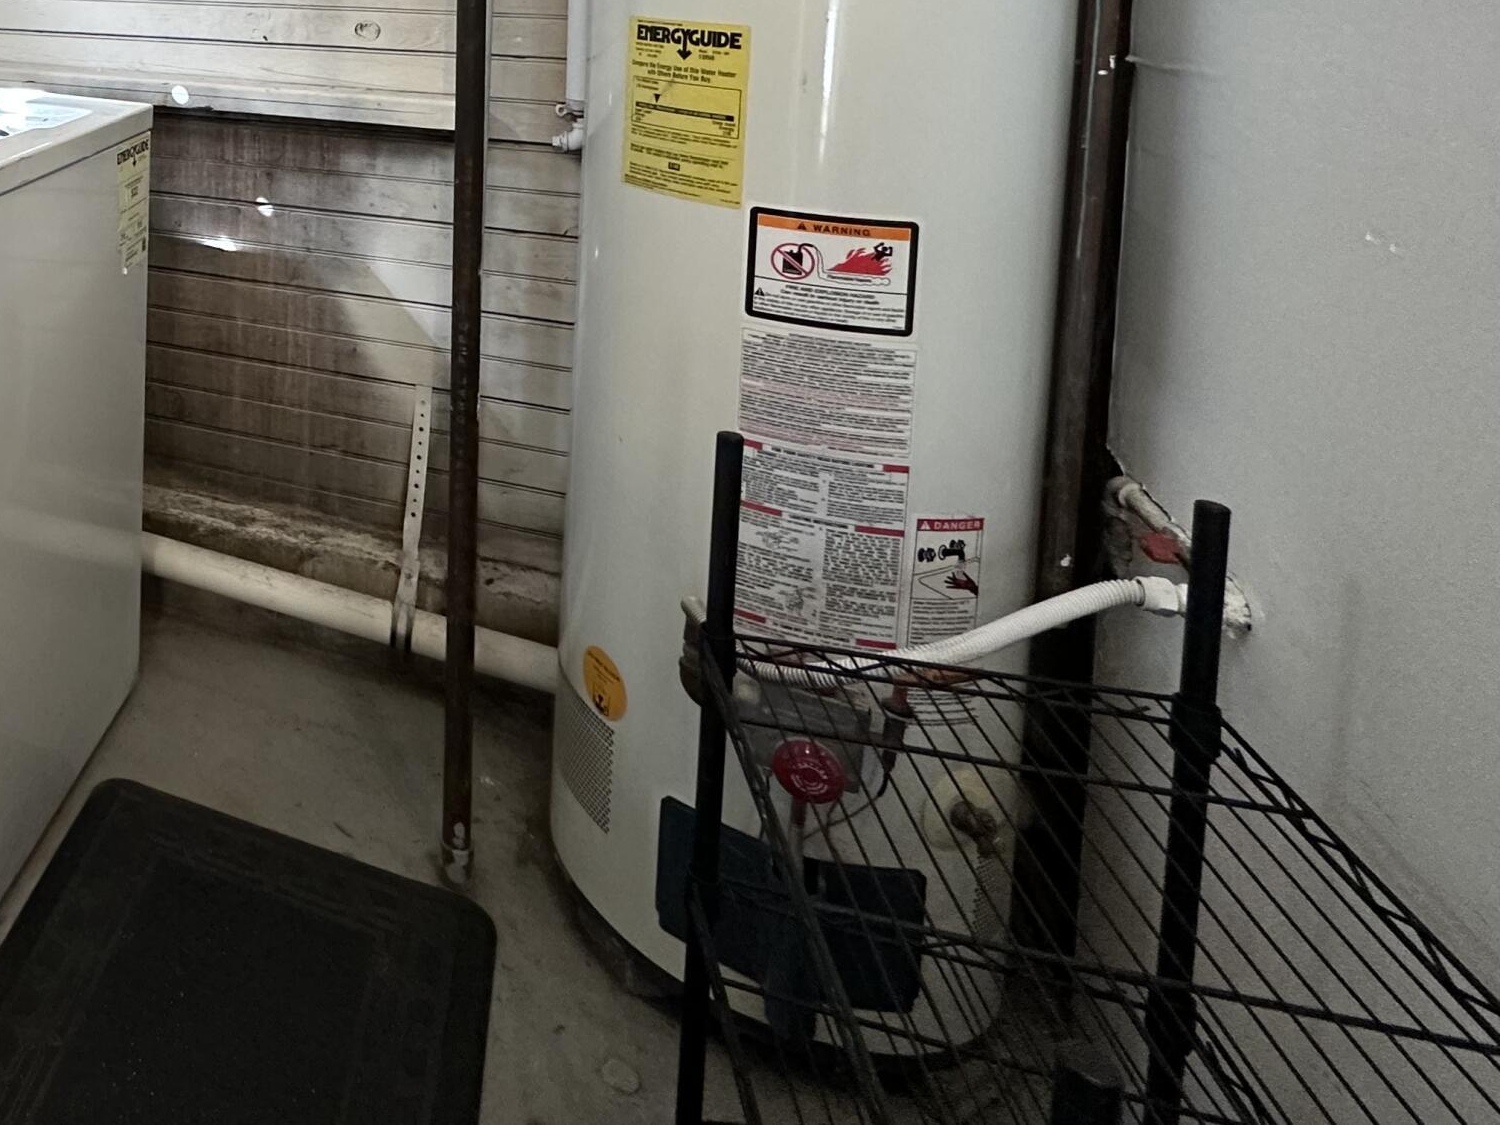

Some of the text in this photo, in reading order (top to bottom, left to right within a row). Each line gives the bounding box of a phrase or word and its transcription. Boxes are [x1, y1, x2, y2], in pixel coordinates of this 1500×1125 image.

[636, 24, 743, 50] ENERGYGUIDE
[813, 224, 872, 237] WARNING
[933, 520, 981, 531] DANGER
